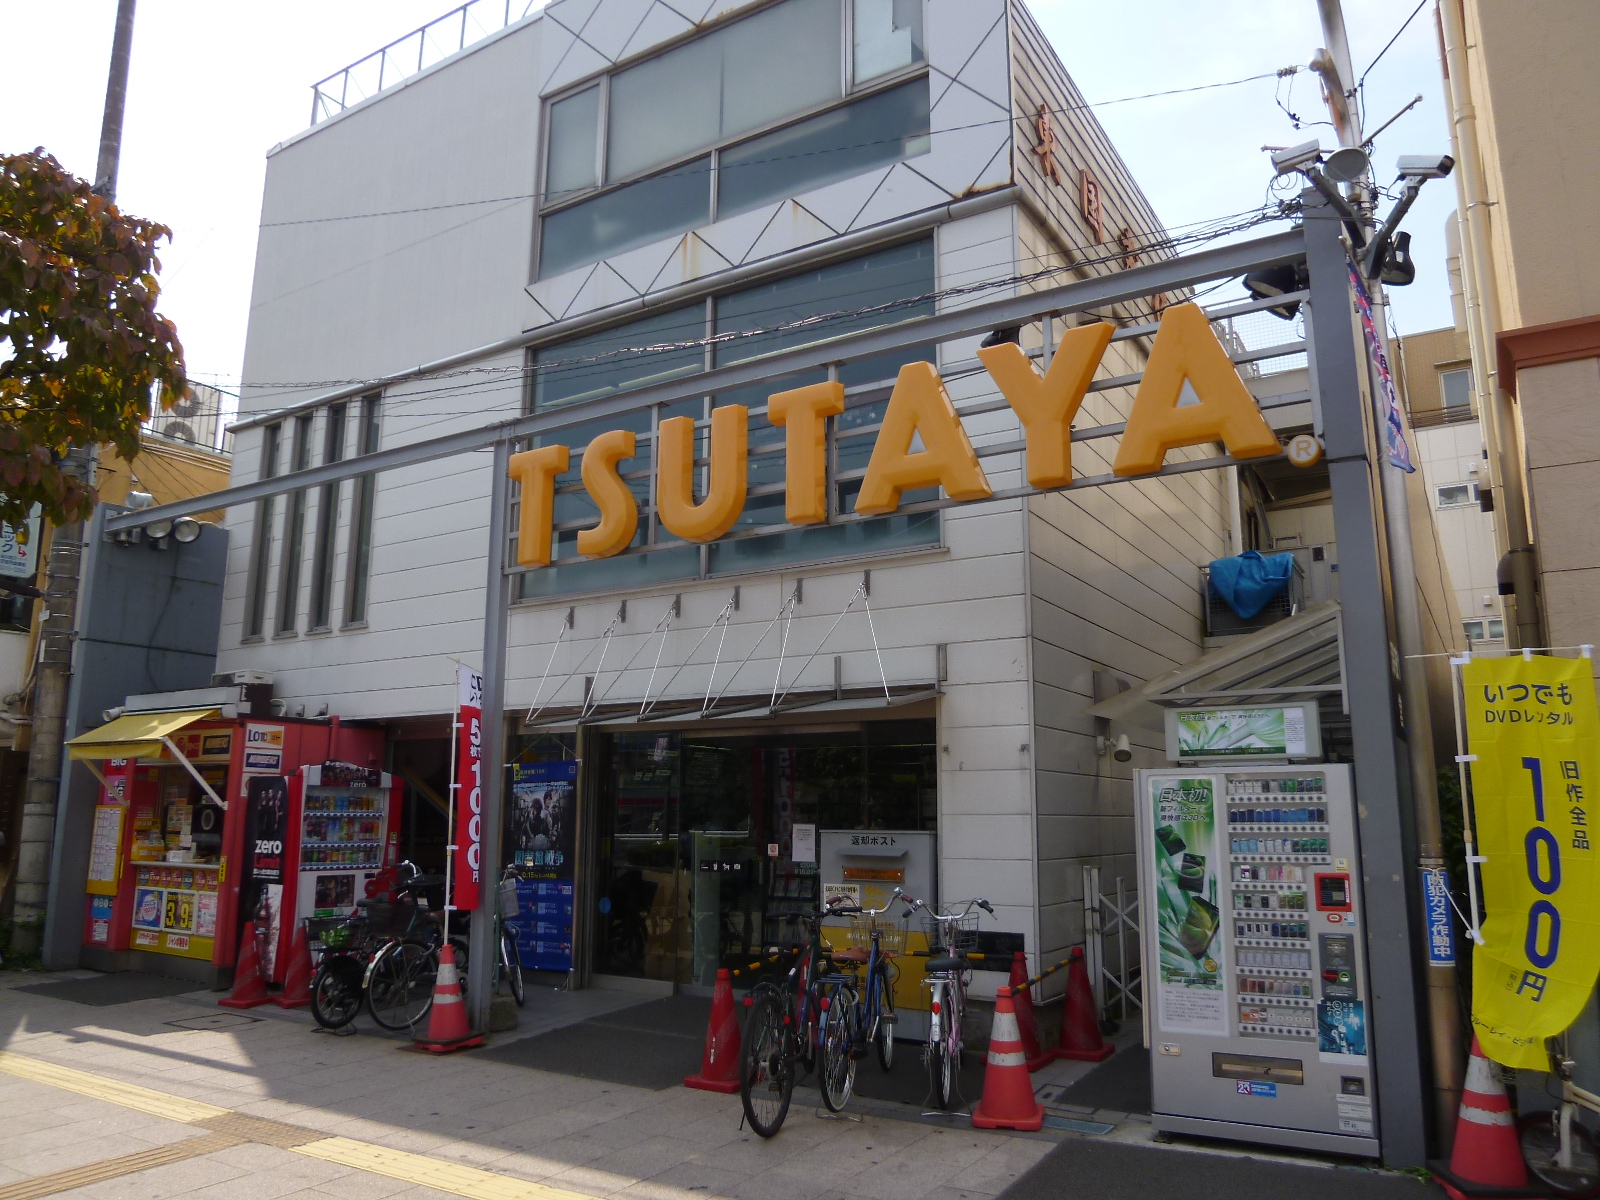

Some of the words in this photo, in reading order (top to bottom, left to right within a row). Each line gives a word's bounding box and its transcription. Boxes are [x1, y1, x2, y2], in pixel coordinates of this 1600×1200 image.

[508, 302, 1283, 567] TSUTAYA
[1484, 682, 1573, 706] いつでも
[1485, 709, 1574, 726] DVDレンタル
[1159, 787, 1208, 803] 日本初!
[1560, 760, 1590, 850] 旧作全品
[254, 839, 282, 855] zero
[851, 835, 896, 846] 返却ポスト
[1426, 874, 1452, 957] 防犯カメラ作動中
